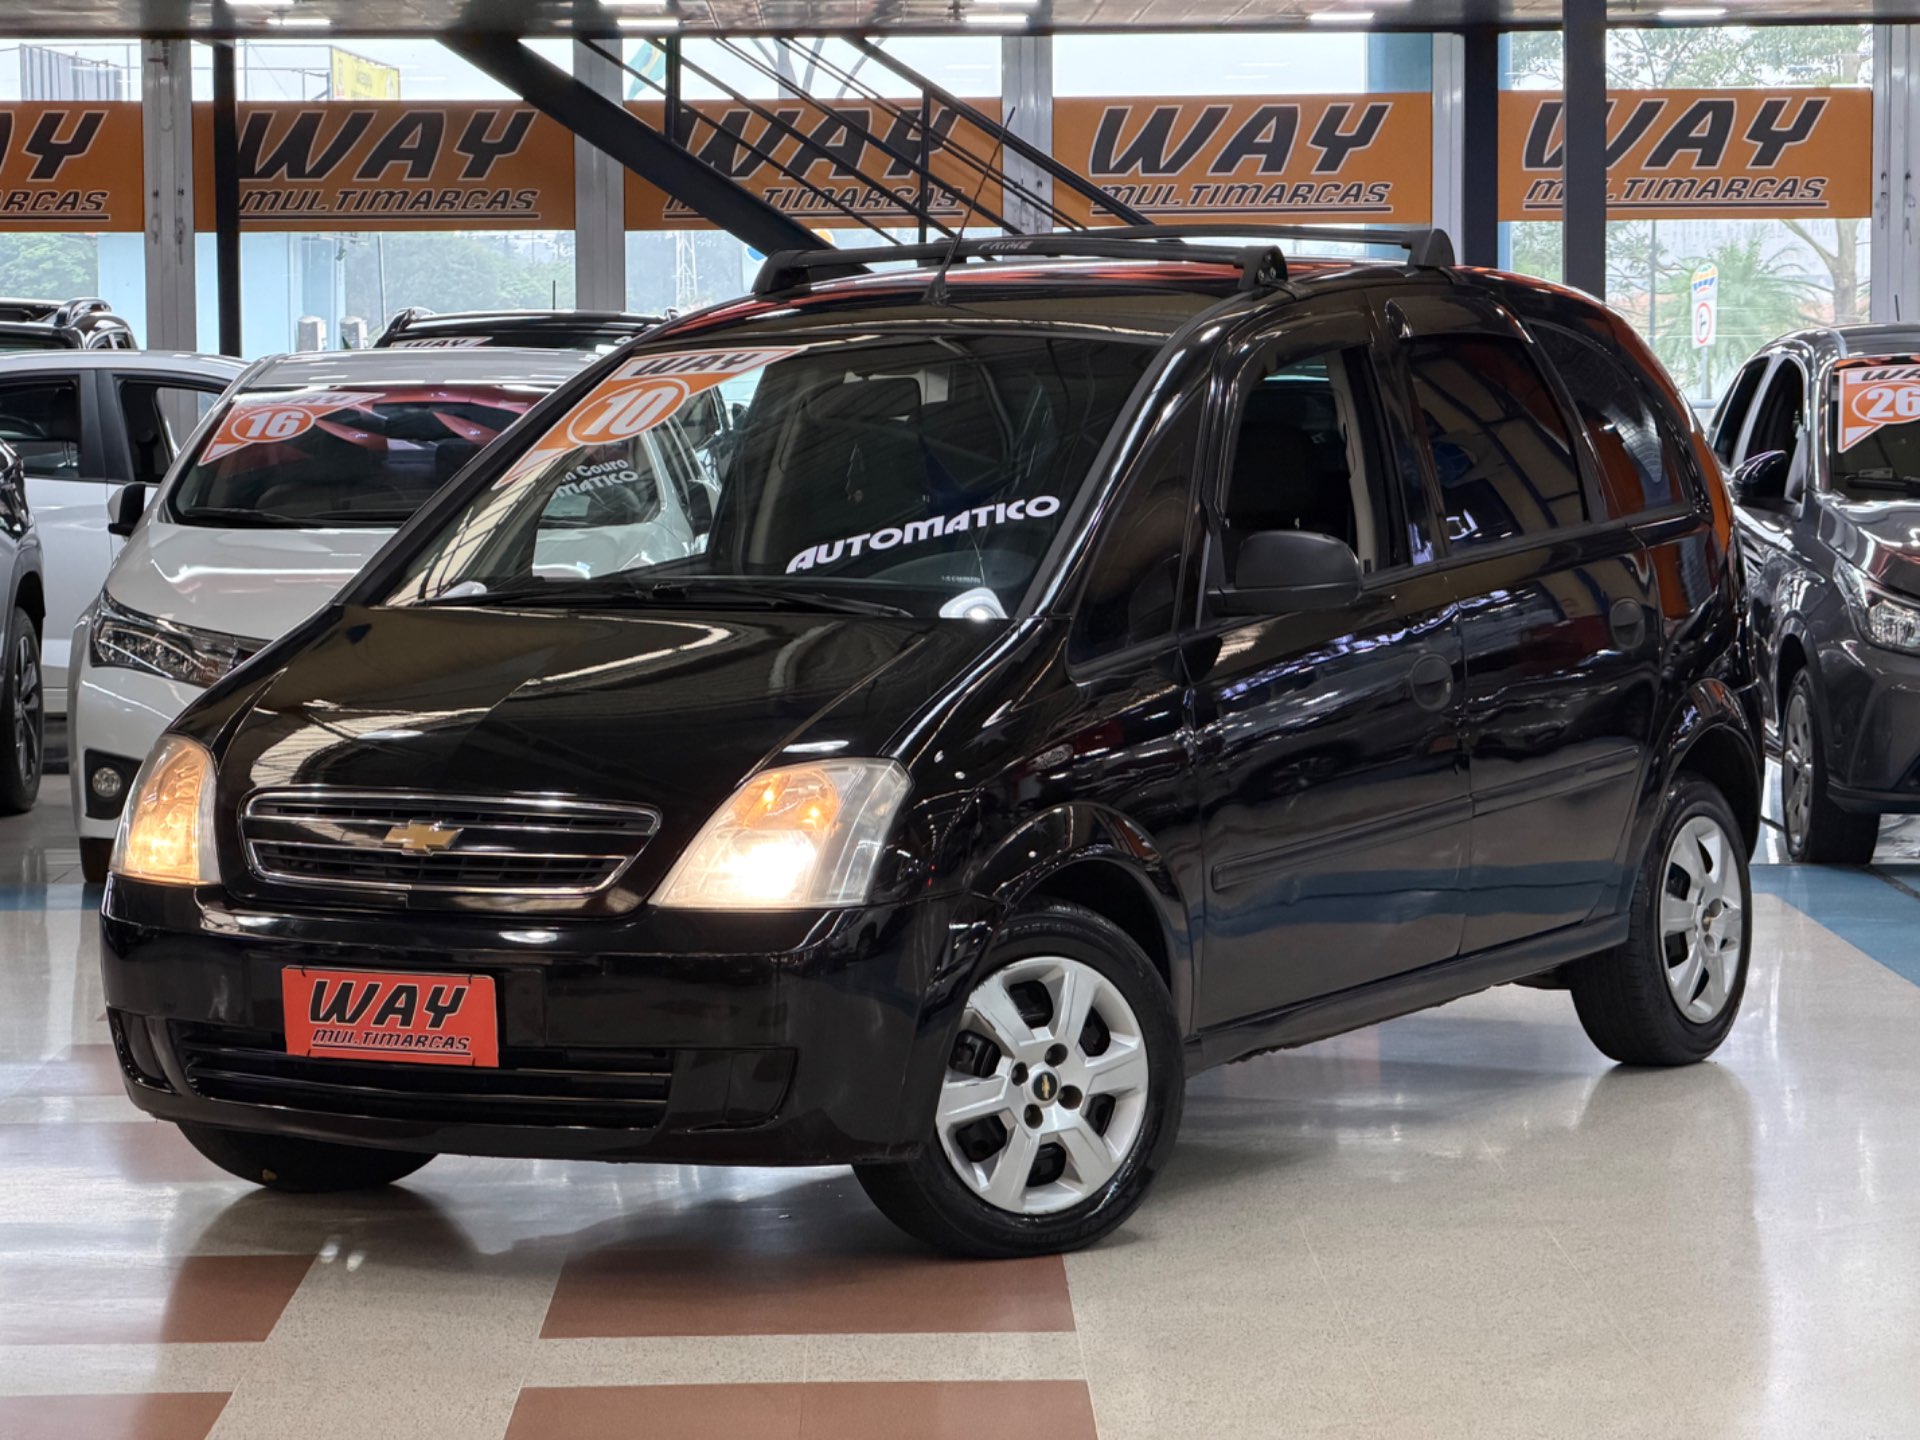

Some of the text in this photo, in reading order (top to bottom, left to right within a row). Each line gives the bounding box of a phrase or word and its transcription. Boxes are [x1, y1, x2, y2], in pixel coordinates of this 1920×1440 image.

[0, 110, 109, 182] Y
[237, 110, 539, 181] WAY
[1089, 102, 1393, 176] WAY
[1522, 97, 1831, 170] WAY
[0, 189, 109, 213] RCAS
[238, 188, 541, 212] MULTIMARCAS
[663, 186, 964, 211] TIMARCAS
[1092, 182, 1393, 208] MULTIMARCAS
[1525, 177, 1829, 201] MTIMARCAS
[631, 353, 761, 377] WAY
[582, 386, 680, 435] 10
[1866, 387, 1920, 418] 26
[245, 411, 305, 438] 16
[576, 459, 629, 476] Couro
[555, 470, 639, 497] MATICO
[785, 495, 1061, 575] AUTOMATICO
[308, 978, 469, 1031] WAY
[312, 1028, 471, 1051] MULTIMARCAS
